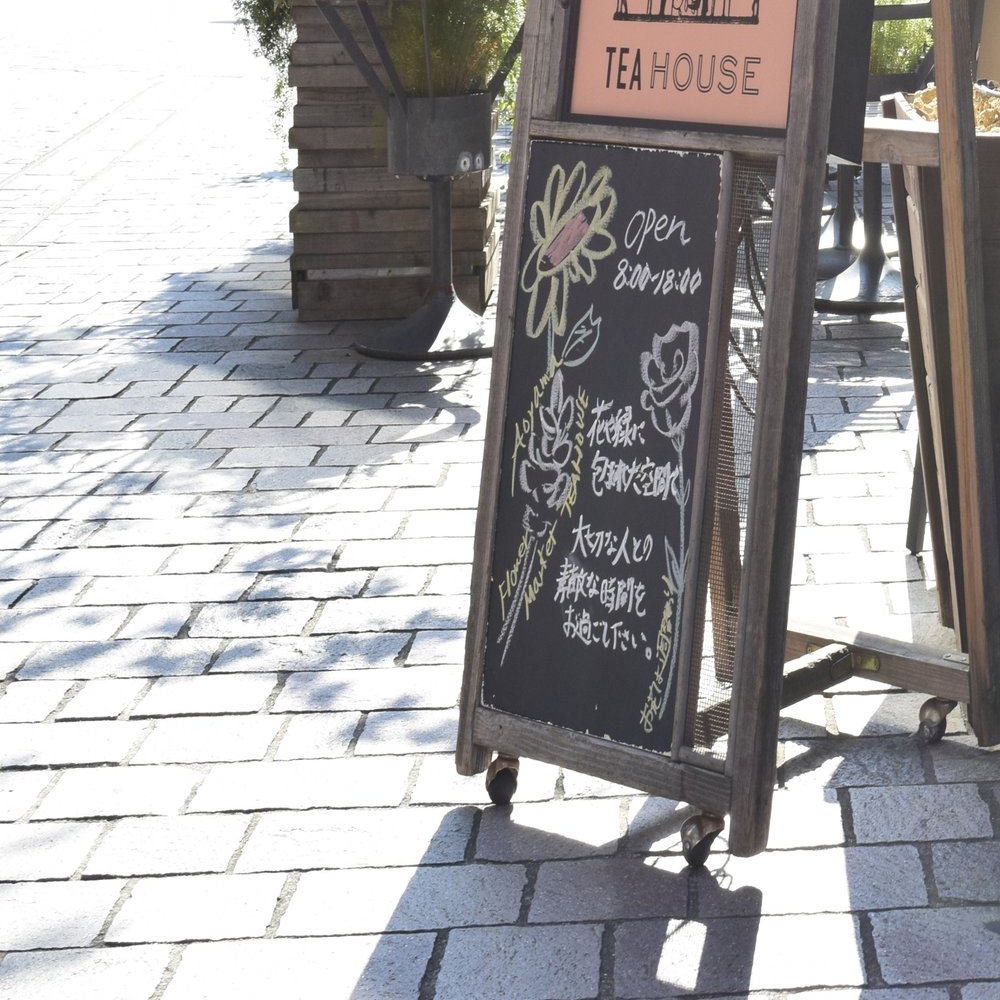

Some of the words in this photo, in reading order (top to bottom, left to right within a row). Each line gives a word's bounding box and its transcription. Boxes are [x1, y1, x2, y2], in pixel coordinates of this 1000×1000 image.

[605, 46, 642, 91] TEA
[650, 52, 761, 96] HOUSE
[571, 514, 654, 566] 大切な人との
[554, 557, 647, 618] 素敵な時間を
[562, 604, 653, 661] お過ごし下さい。
